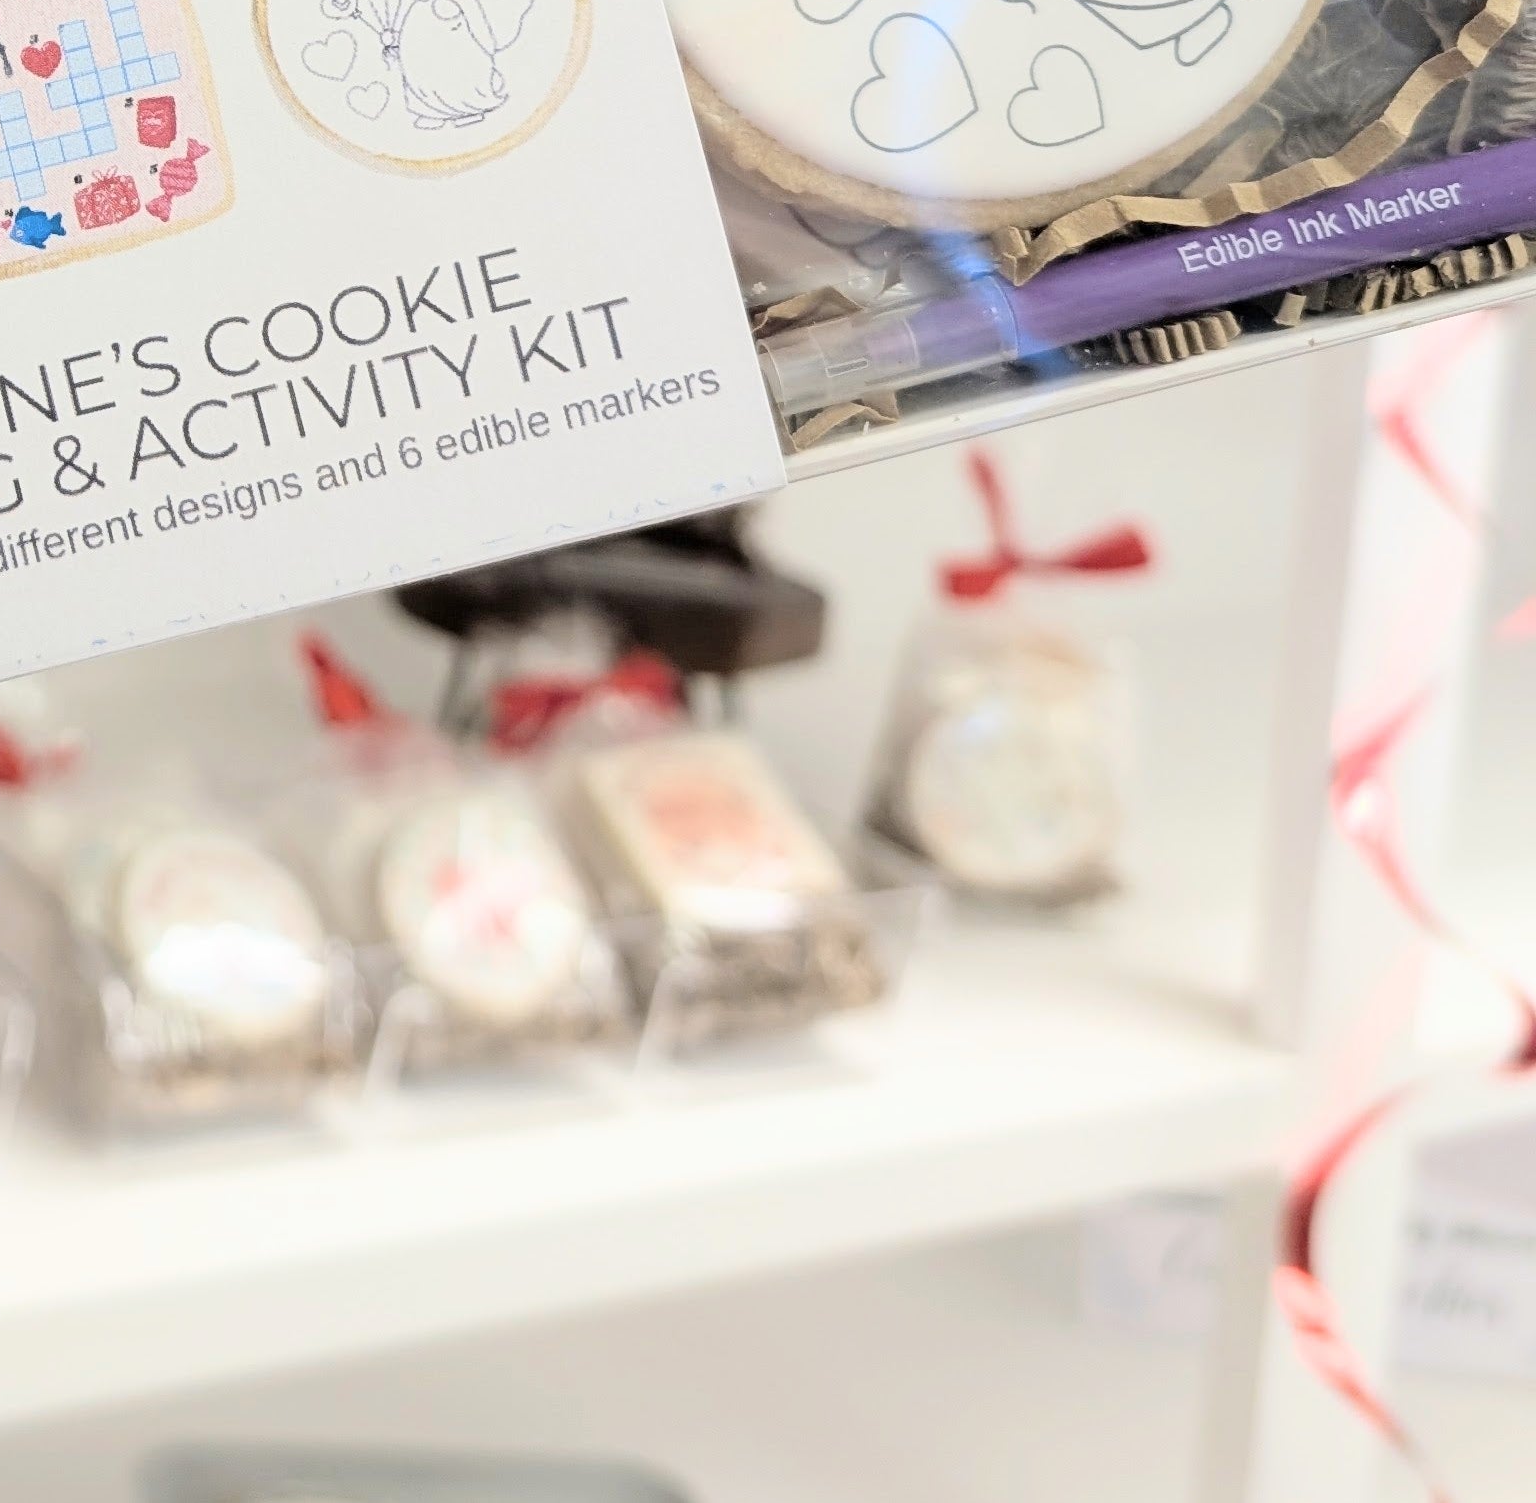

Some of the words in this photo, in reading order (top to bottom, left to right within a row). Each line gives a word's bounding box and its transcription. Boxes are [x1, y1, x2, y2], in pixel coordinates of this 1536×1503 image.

[1175, 227, 1284, 274] Edible
[1288, 210, 1345, 246] Ink
[1345, 181, 1463, 230] Marker
[203, 246, 532, 377] COOKIE
[52, 434, 106, 497] &
[129, 333, 478, 481] ACTIVITY
[509, 296, 629, 383] KIT
[153, 471, 305, 531] designs
[315, 442, 387, 492] and
[397, 436, 424, 469] 6
[434, 407, 551, 461] edible
[562, 367, 721, 430] markers
